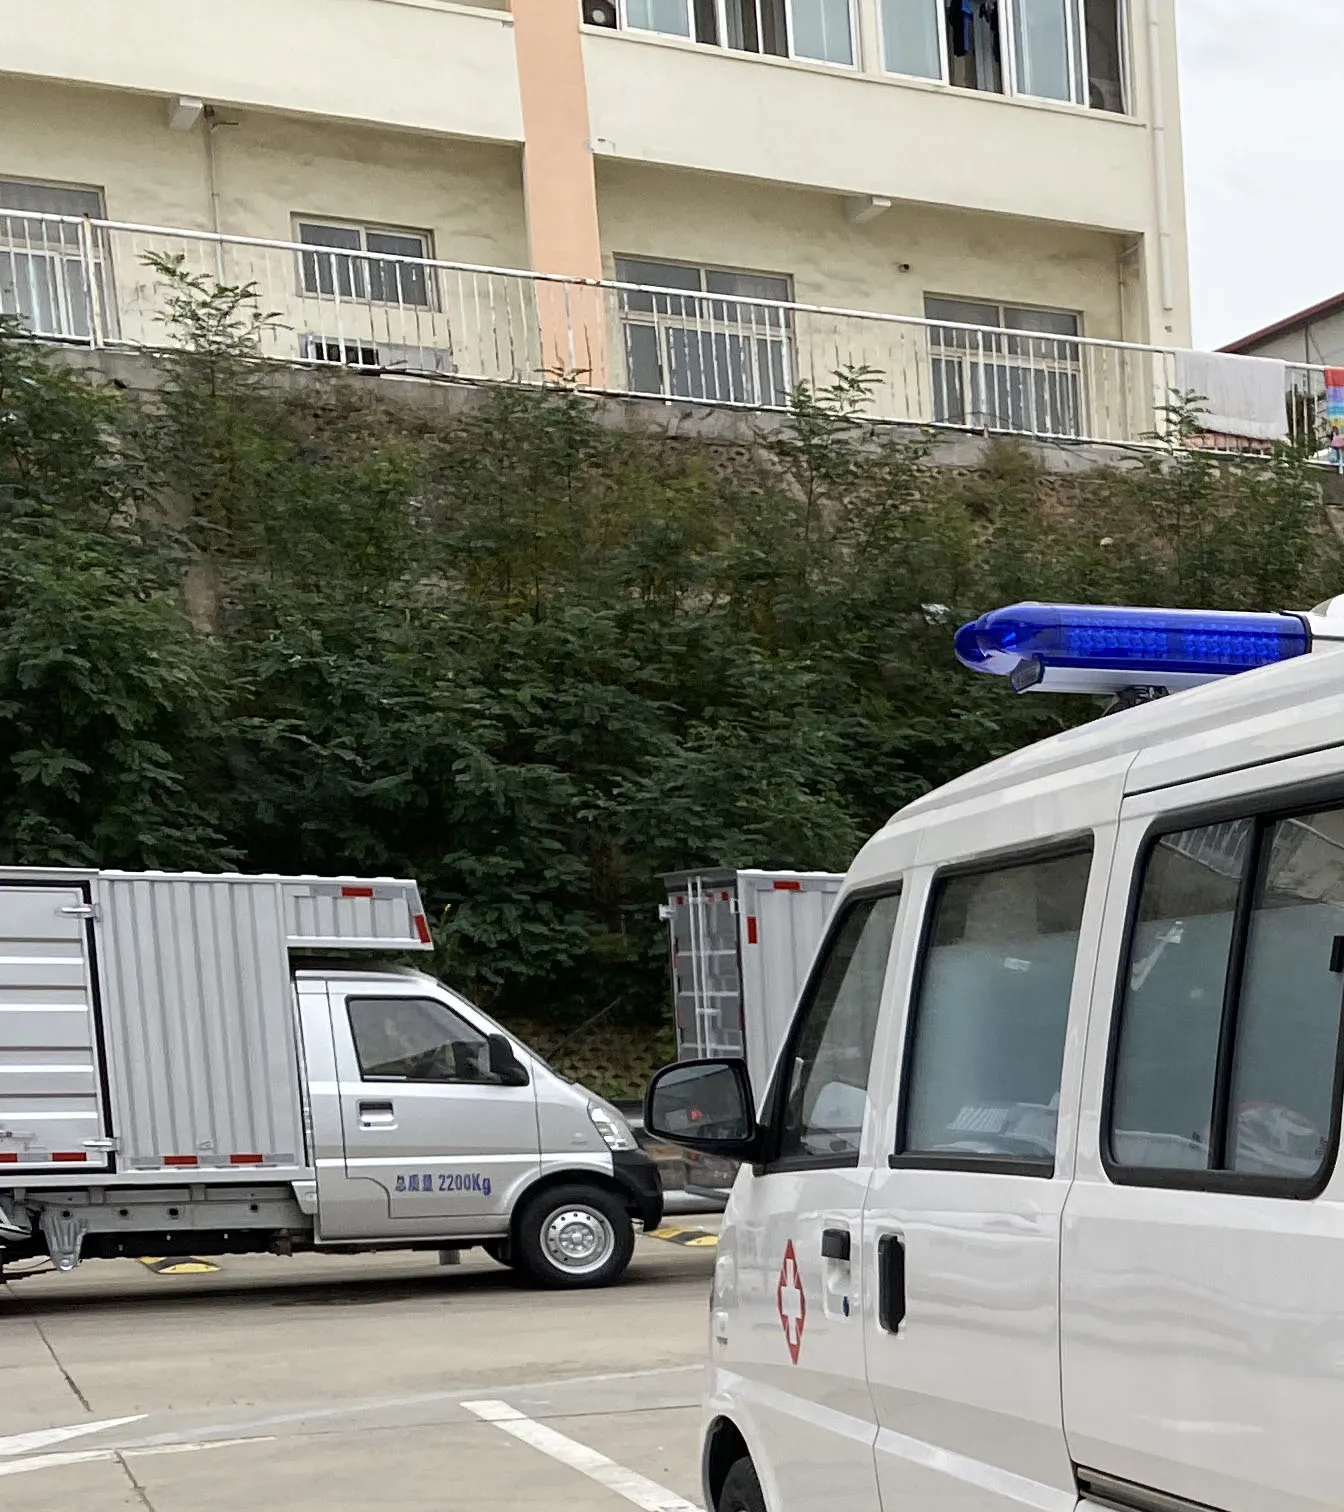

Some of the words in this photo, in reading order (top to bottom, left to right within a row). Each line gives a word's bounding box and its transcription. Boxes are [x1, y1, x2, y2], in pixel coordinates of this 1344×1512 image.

[395, 1173, 433, 1192] 总质量
[438, 1173, 491, 1196] 2200Kg
